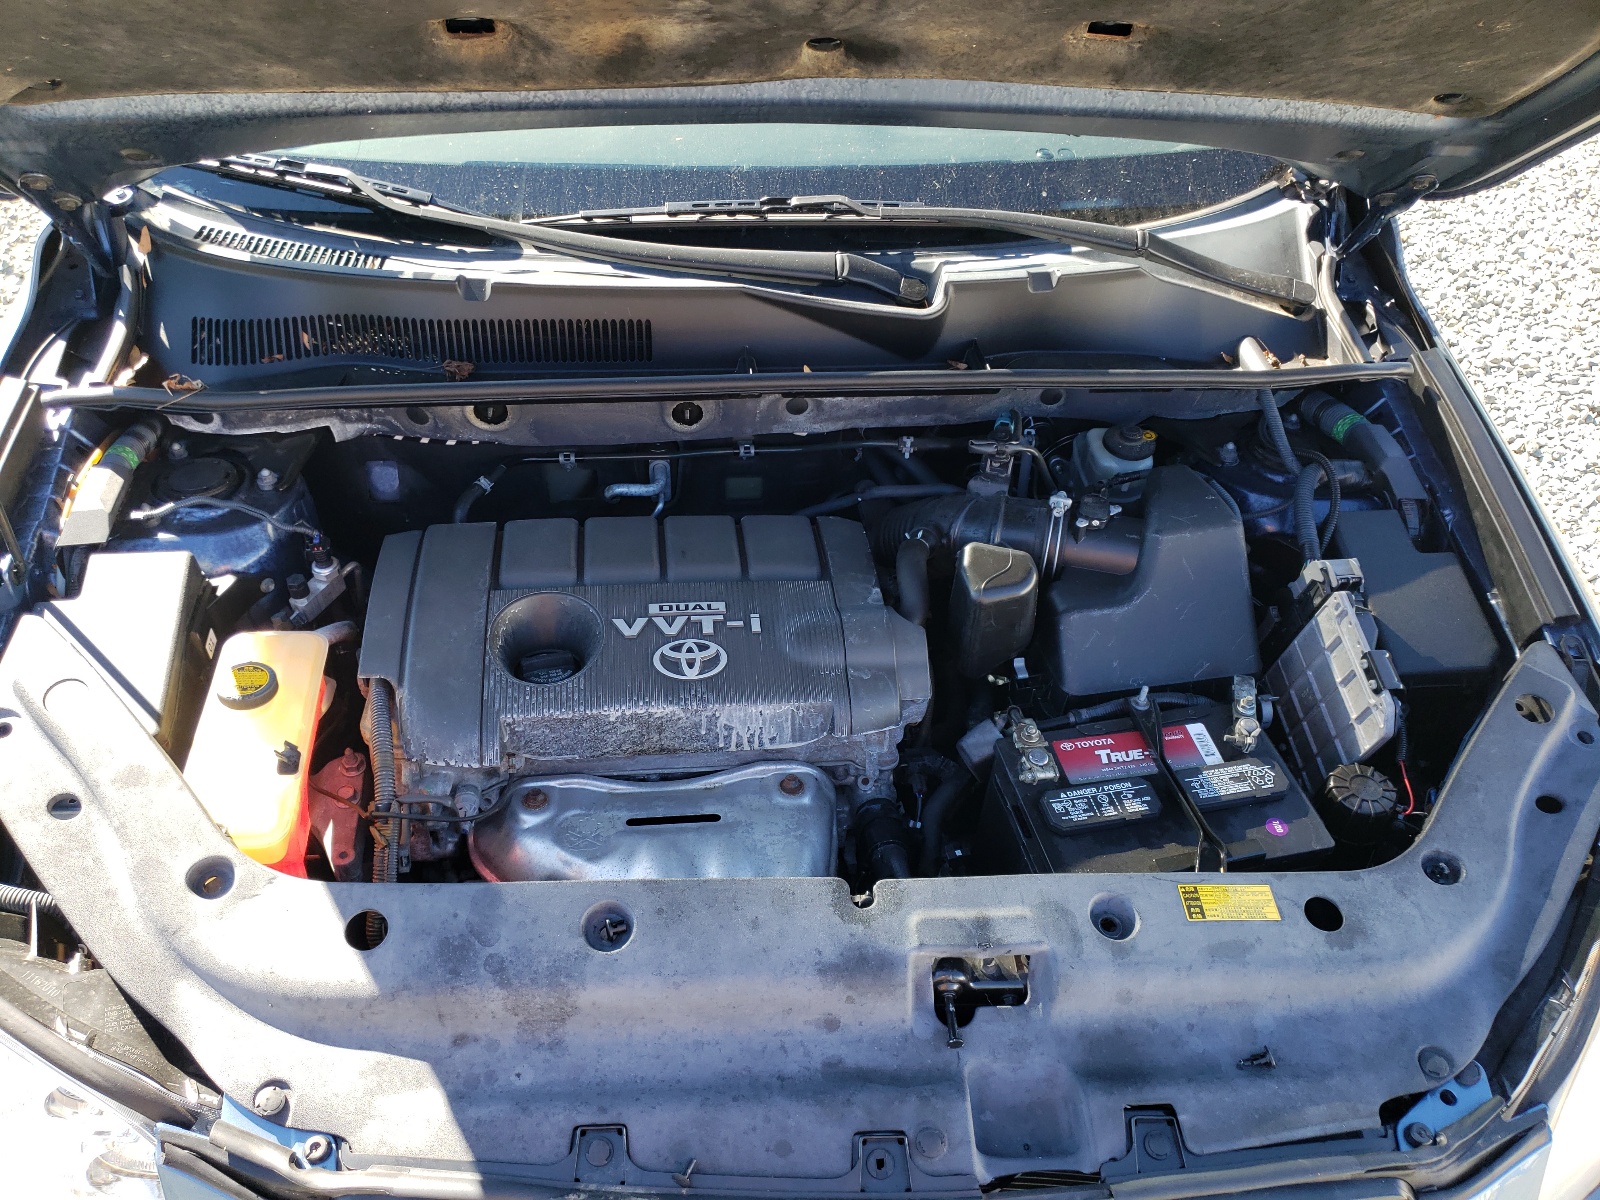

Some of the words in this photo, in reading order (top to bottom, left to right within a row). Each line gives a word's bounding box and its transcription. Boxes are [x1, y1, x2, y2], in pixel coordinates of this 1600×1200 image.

[659, 603, 719, 611] DUAL
[612, 613, 762, 639] VVT-i
[1075, 738, 1115, 749] TOYOTA
[1067, 787, 1097, 798] DANGER
[1104, 781, 1132, 792] POISON
